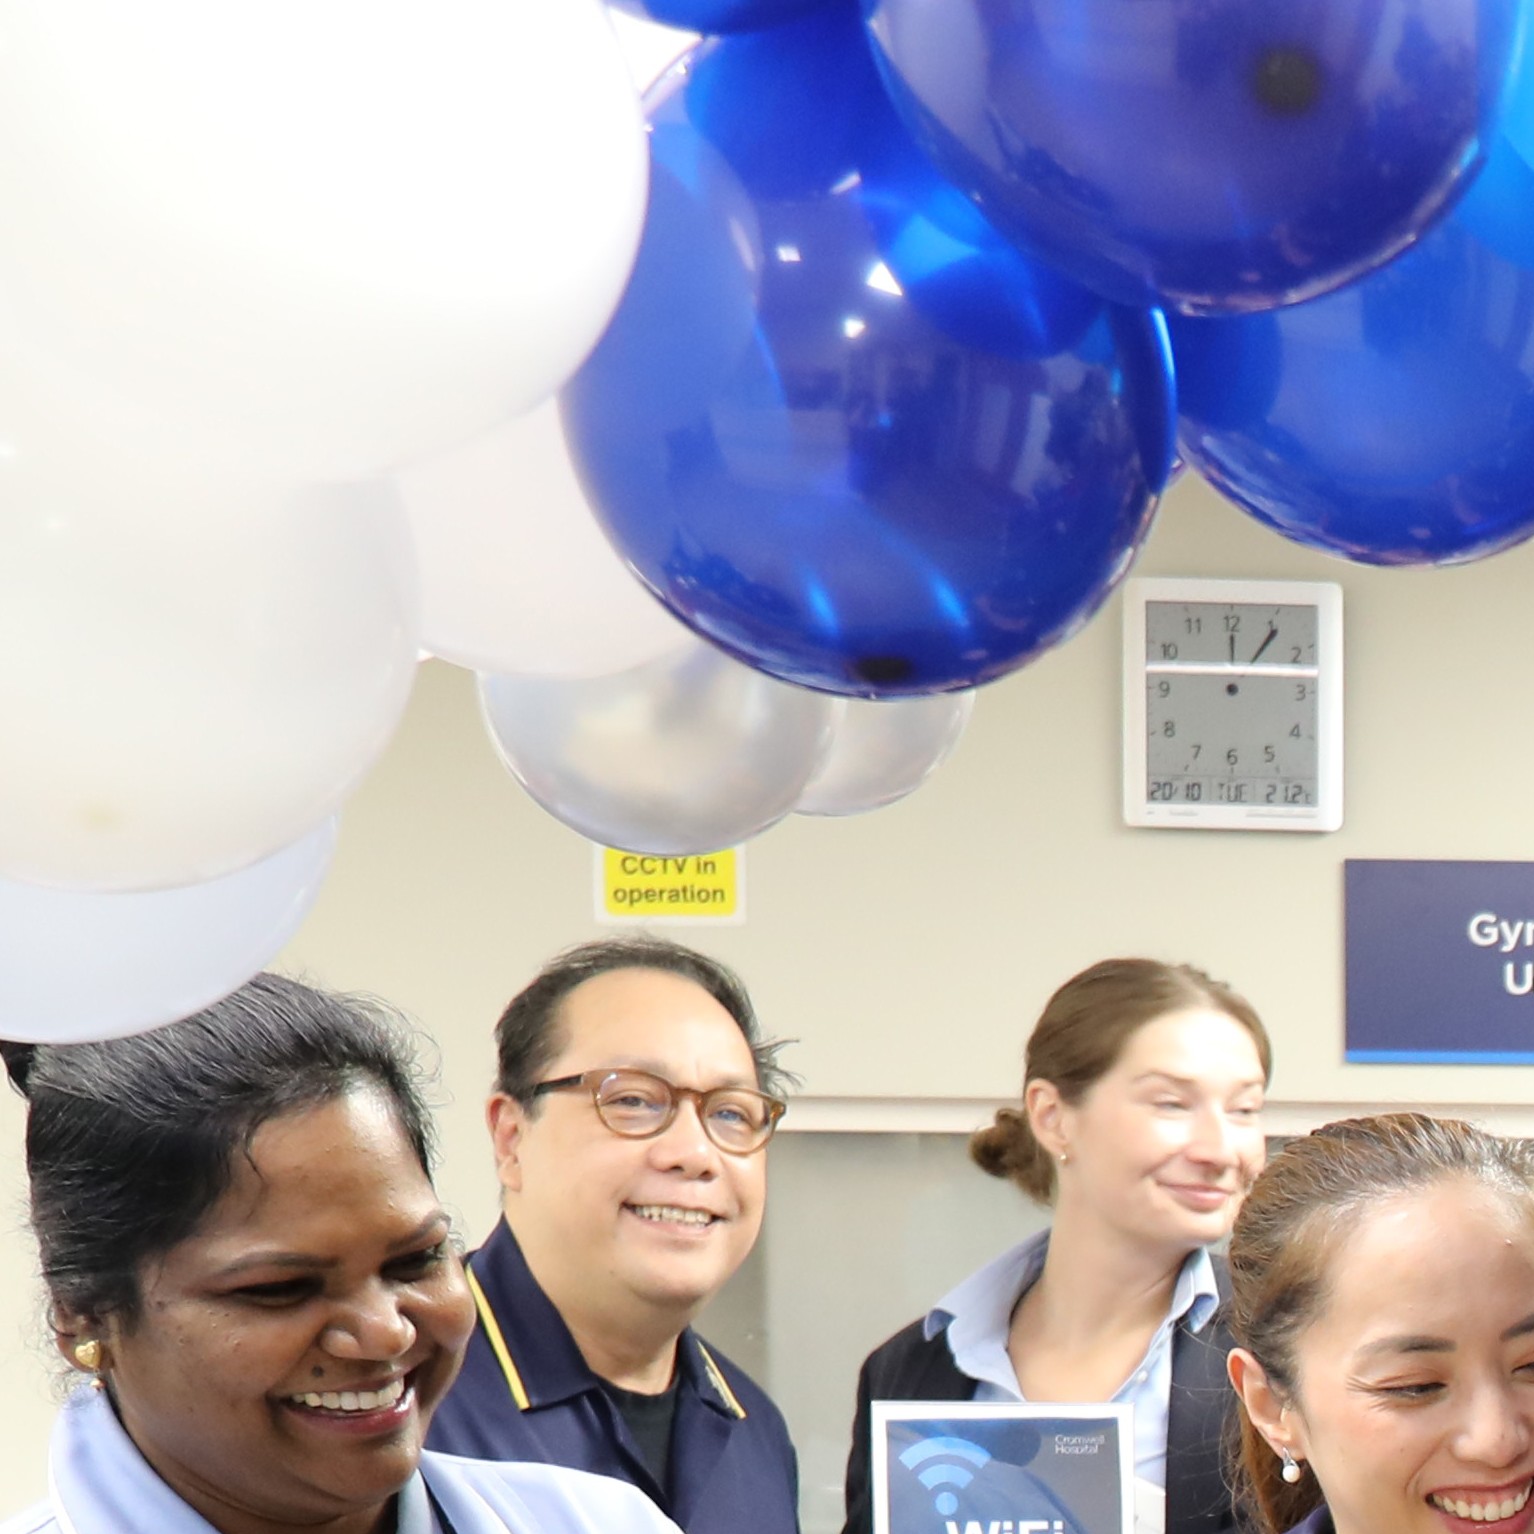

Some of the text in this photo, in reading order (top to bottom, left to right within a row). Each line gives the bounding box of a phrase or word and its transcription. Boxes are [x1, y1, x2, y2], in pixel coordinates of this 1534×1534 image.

[1184, 617, 1202, 634] 11
[1223, 615, 1241, 632] 12
[1161, 643, 1302, 664] 10 2
[1158, 680, 1307, 701] 9 3
[1163, 720, 1301, 738] 8 4
[1190, 745, 1276, 766] 7 6 5
[621, 856, 717, 875] CCTV in
[612, 884, 726, 907] operation
